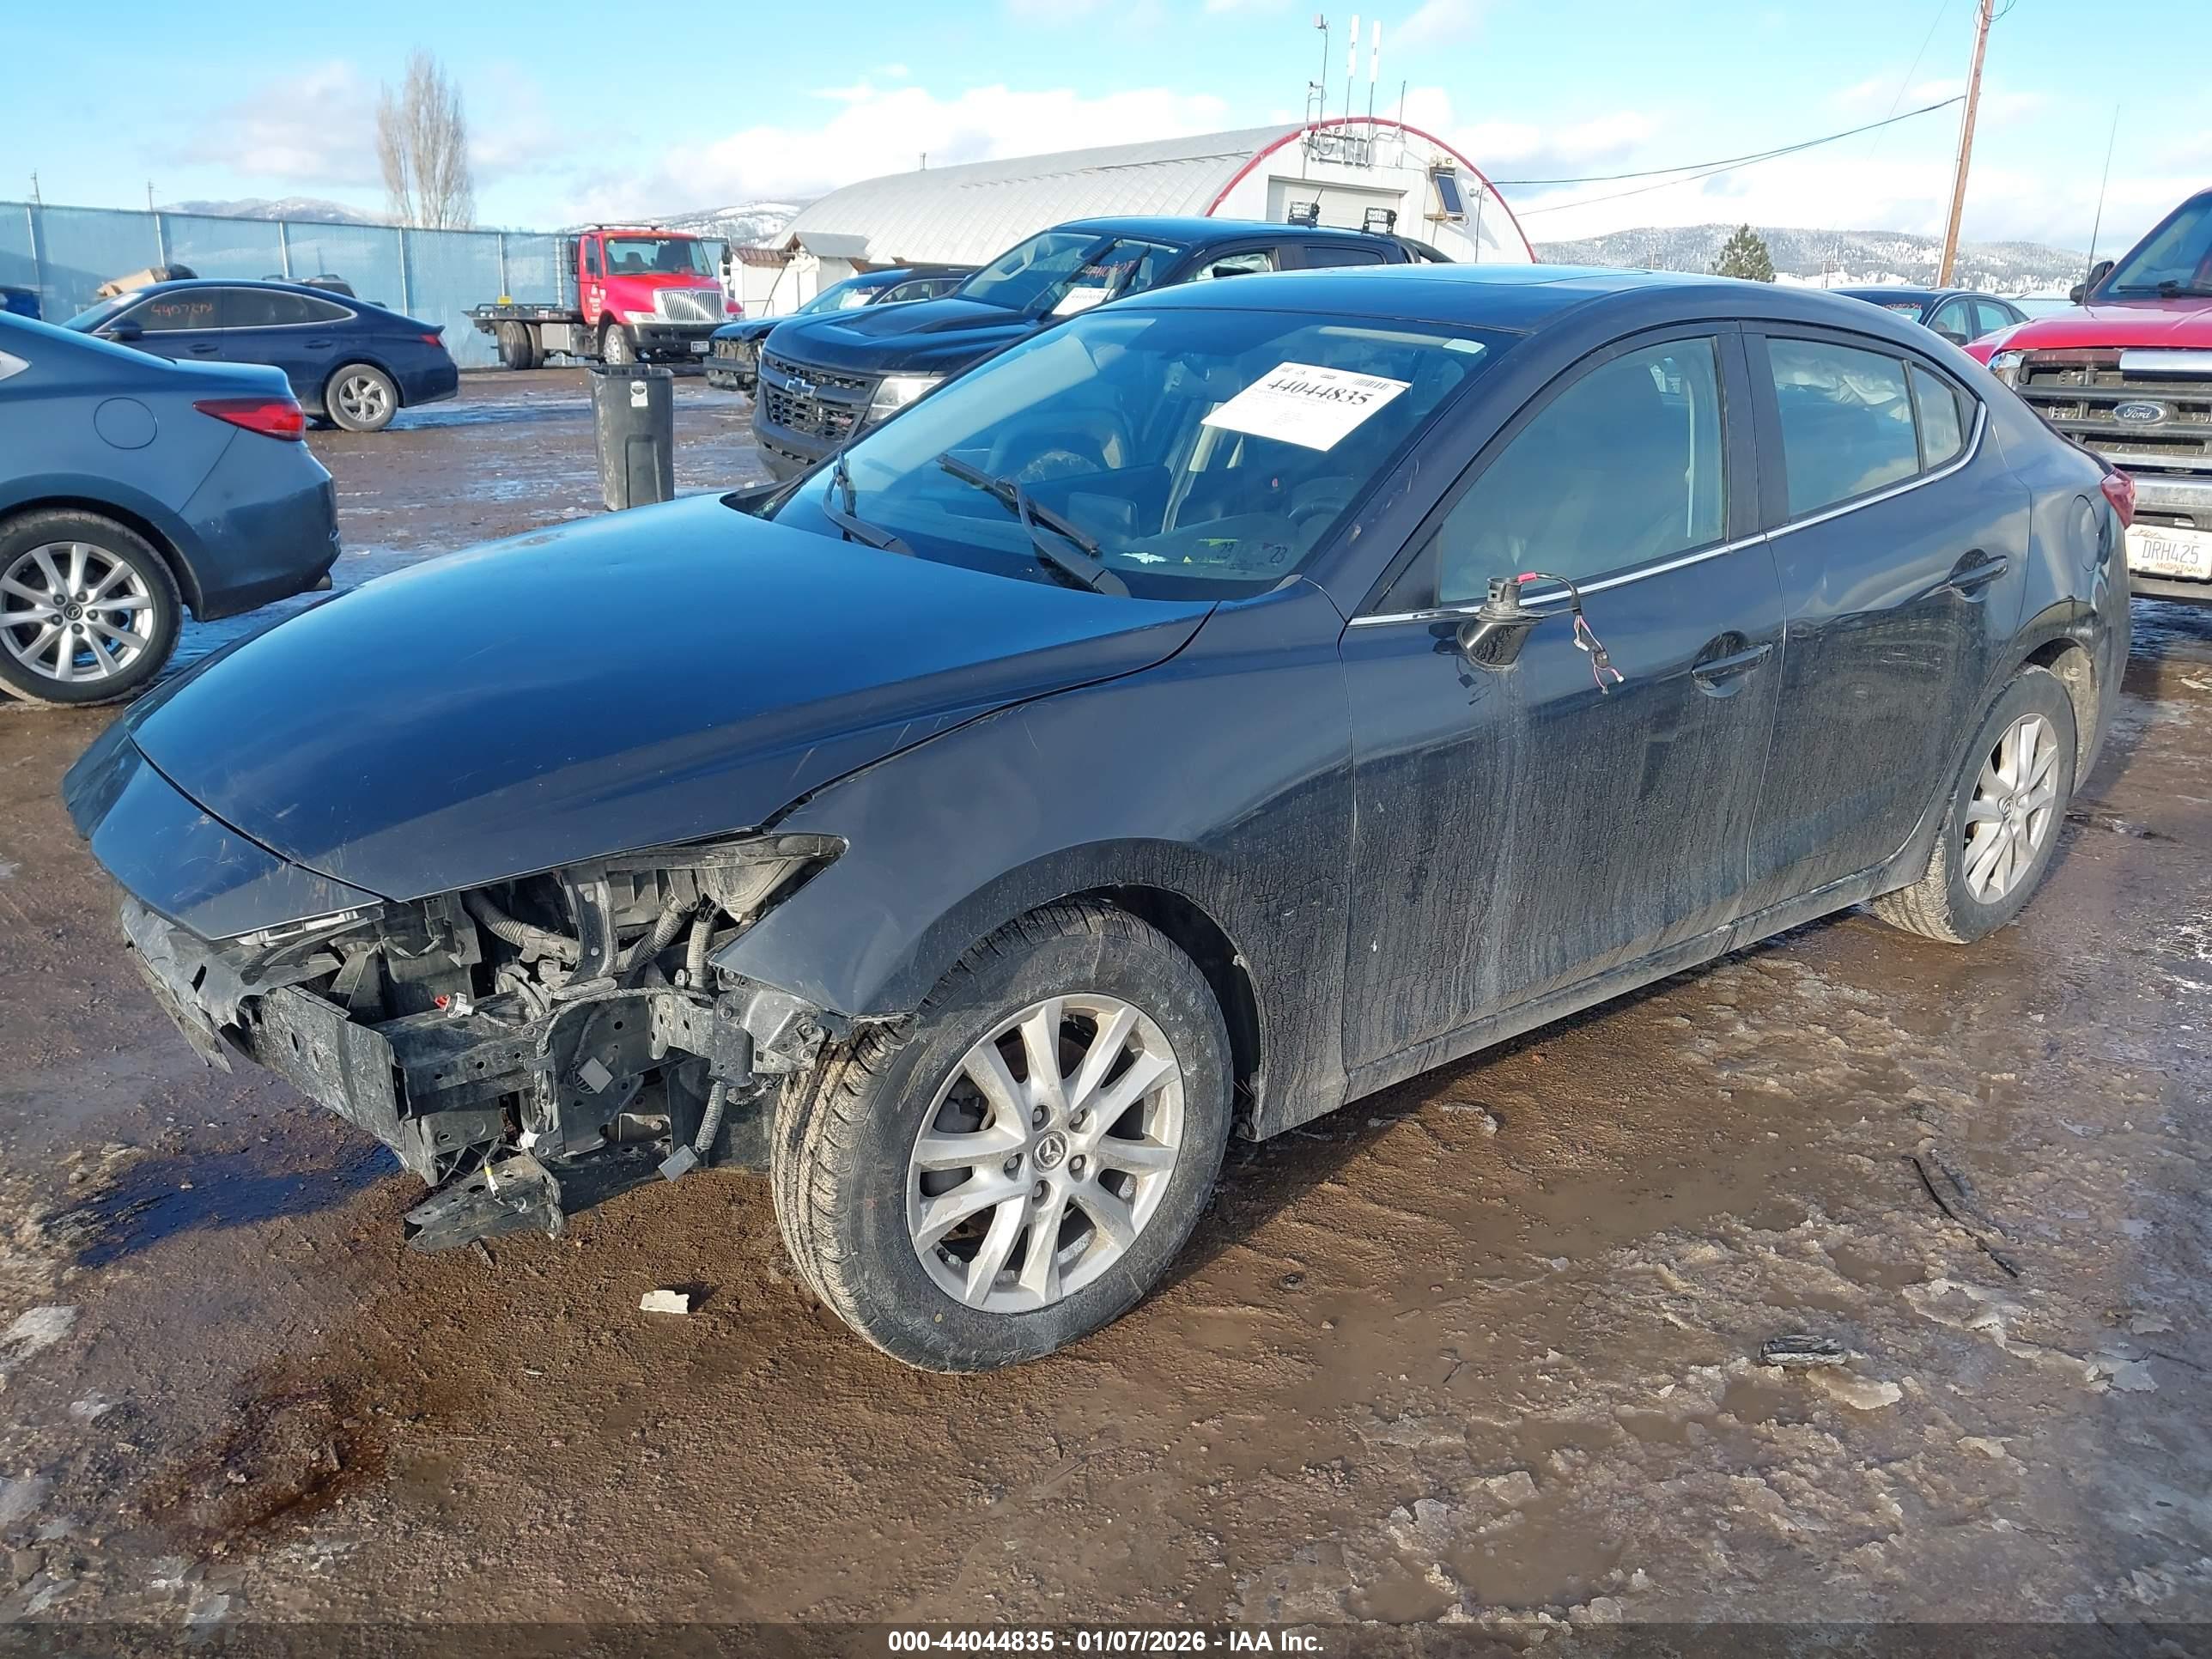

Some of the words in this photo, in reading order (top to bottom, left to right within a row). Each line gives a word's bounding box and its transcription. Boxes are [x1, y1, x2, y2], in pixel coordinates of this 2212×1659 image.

[1267, 378, 1375, 405] 44044835
[2123, 405, 2154, 419] Ford
[2142, 539, 2201, 565] DRH425
[2155, 562, 2203, 574] MONTANA
